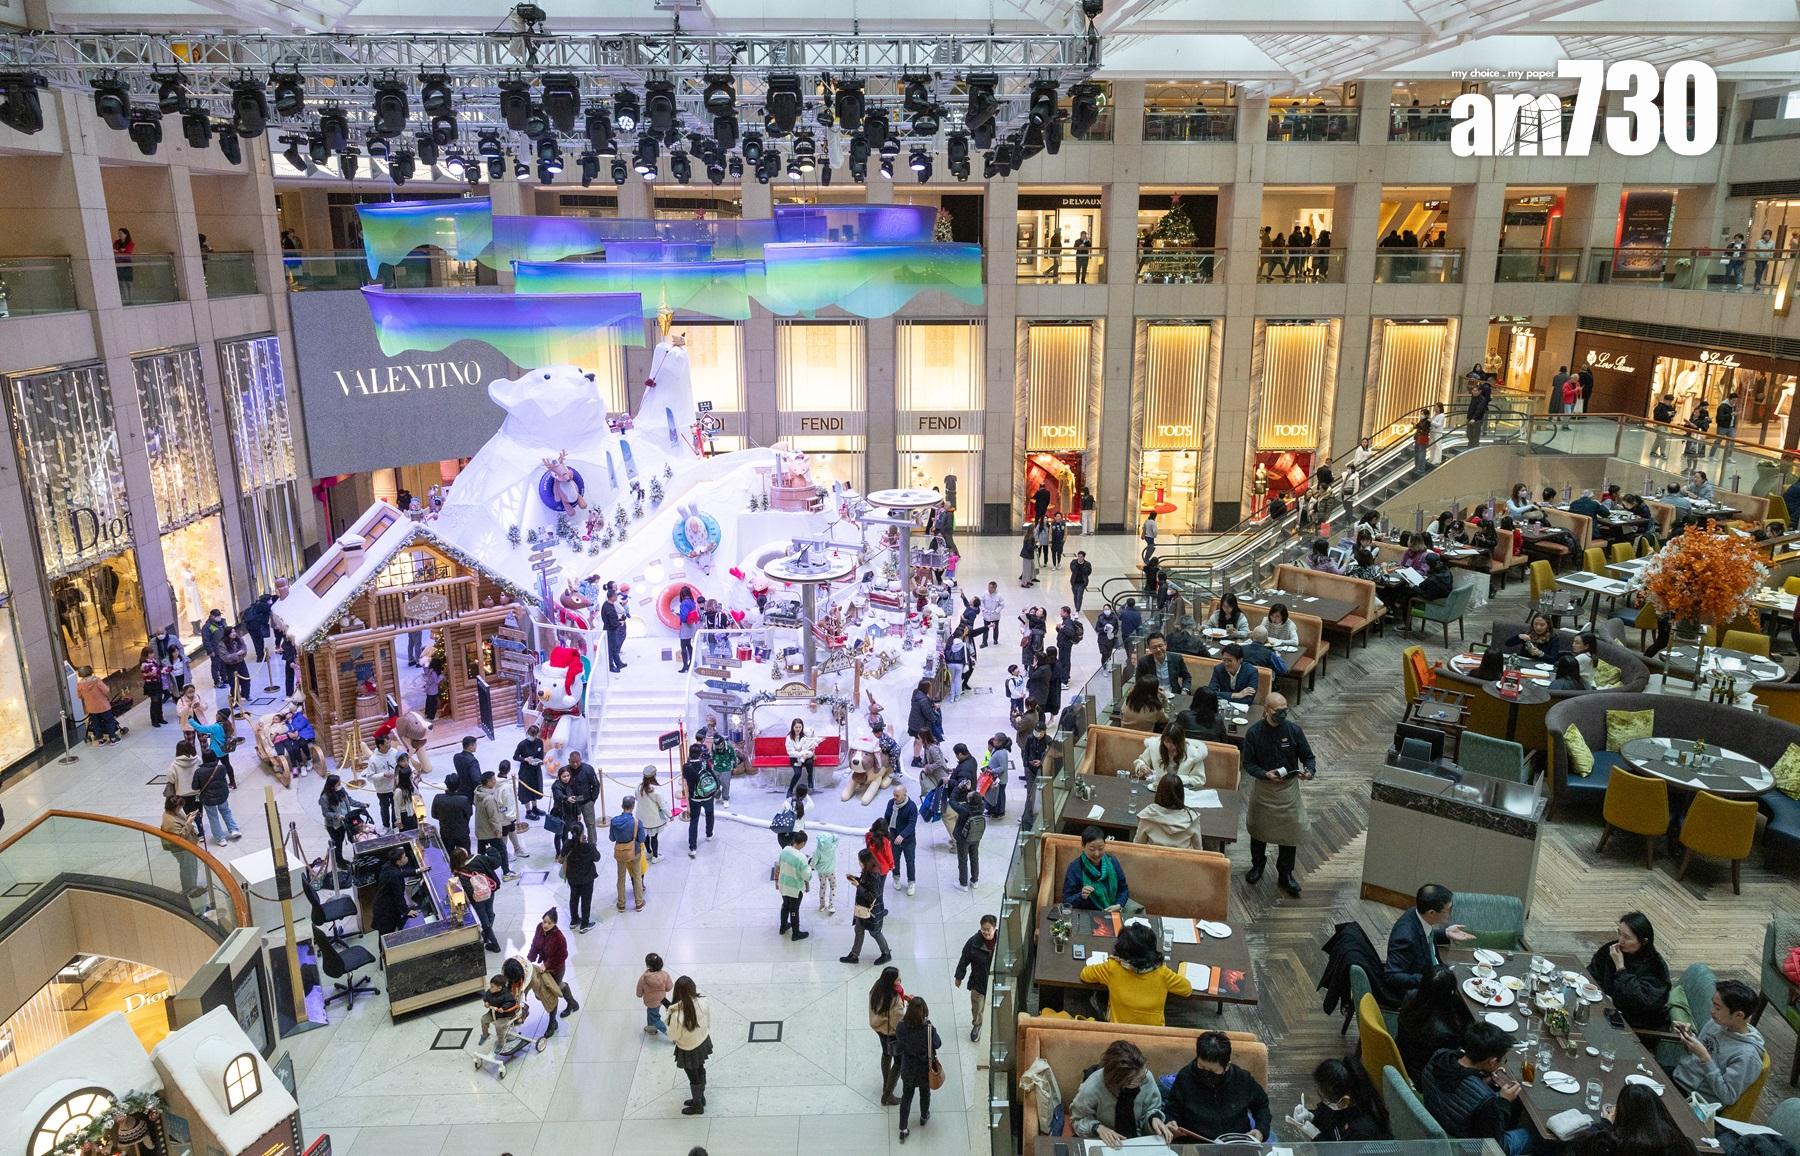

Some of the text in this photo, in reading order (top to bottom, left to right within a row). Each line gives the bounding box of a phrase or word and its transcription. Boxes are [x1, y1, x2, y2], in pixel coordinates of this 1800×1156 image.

[333, 360, 482, 396] VALENTINO
[801, 417, 844, 430] FENDI
[919, 416, 961, 430] FENDI
[1041, 425, 1077, 437] TOD'S
[1157, 424, 1193, 437] TOD'S
[1274, 424, 1308, 437] TOD'S
[68, 508, 133, 554] Dior
[123, 989, 169, 1014] Dior
